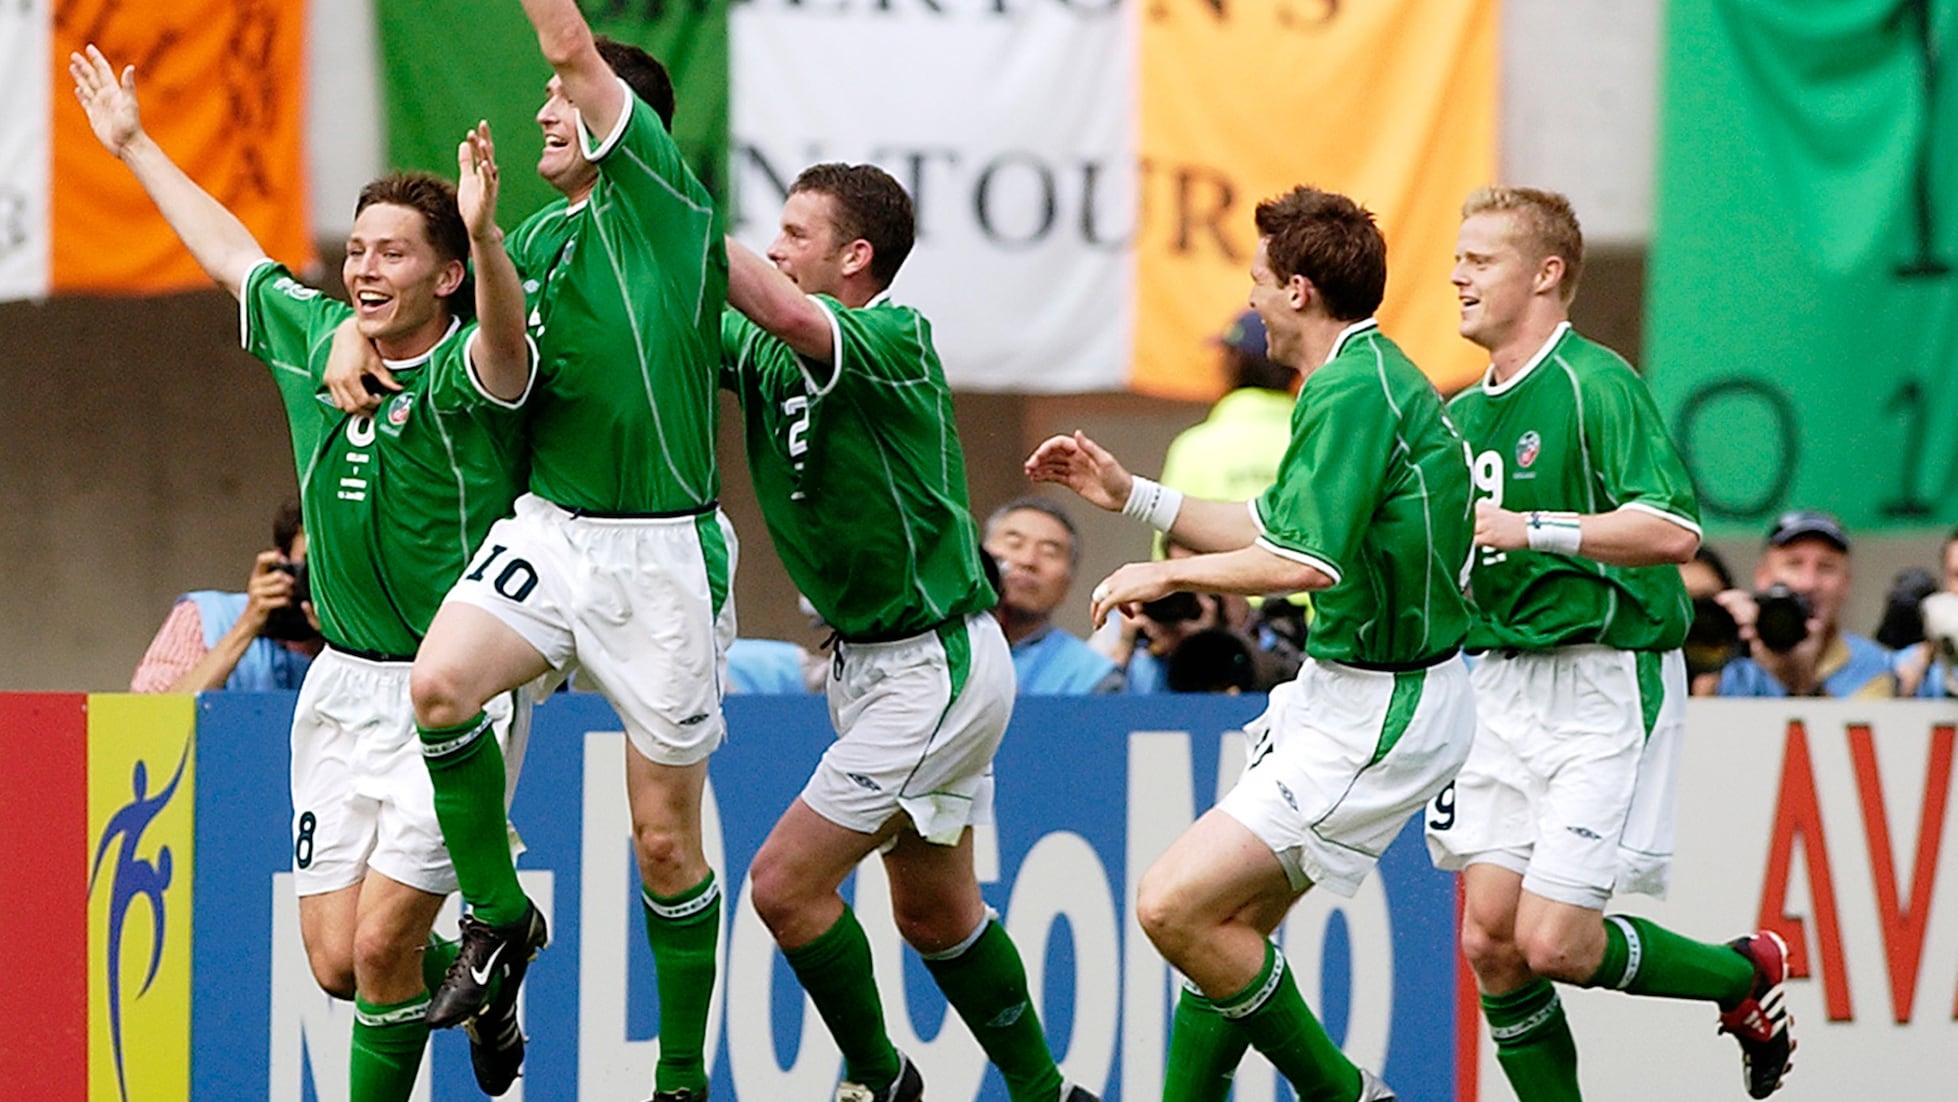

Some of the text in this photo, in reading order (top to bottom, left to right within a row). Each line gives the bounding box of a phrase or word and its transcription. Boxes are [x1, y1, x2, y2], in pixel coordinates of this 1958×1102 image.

[868, 145, 1247, 265] TOUR
[1474, 450, 1505, 509] 9
[465, 544, 539, 603] 10
[1429, 779, 1456, 831] 9
[296, 810, 317, 870] 8
[1756, 718, 1958, 1025] AV
